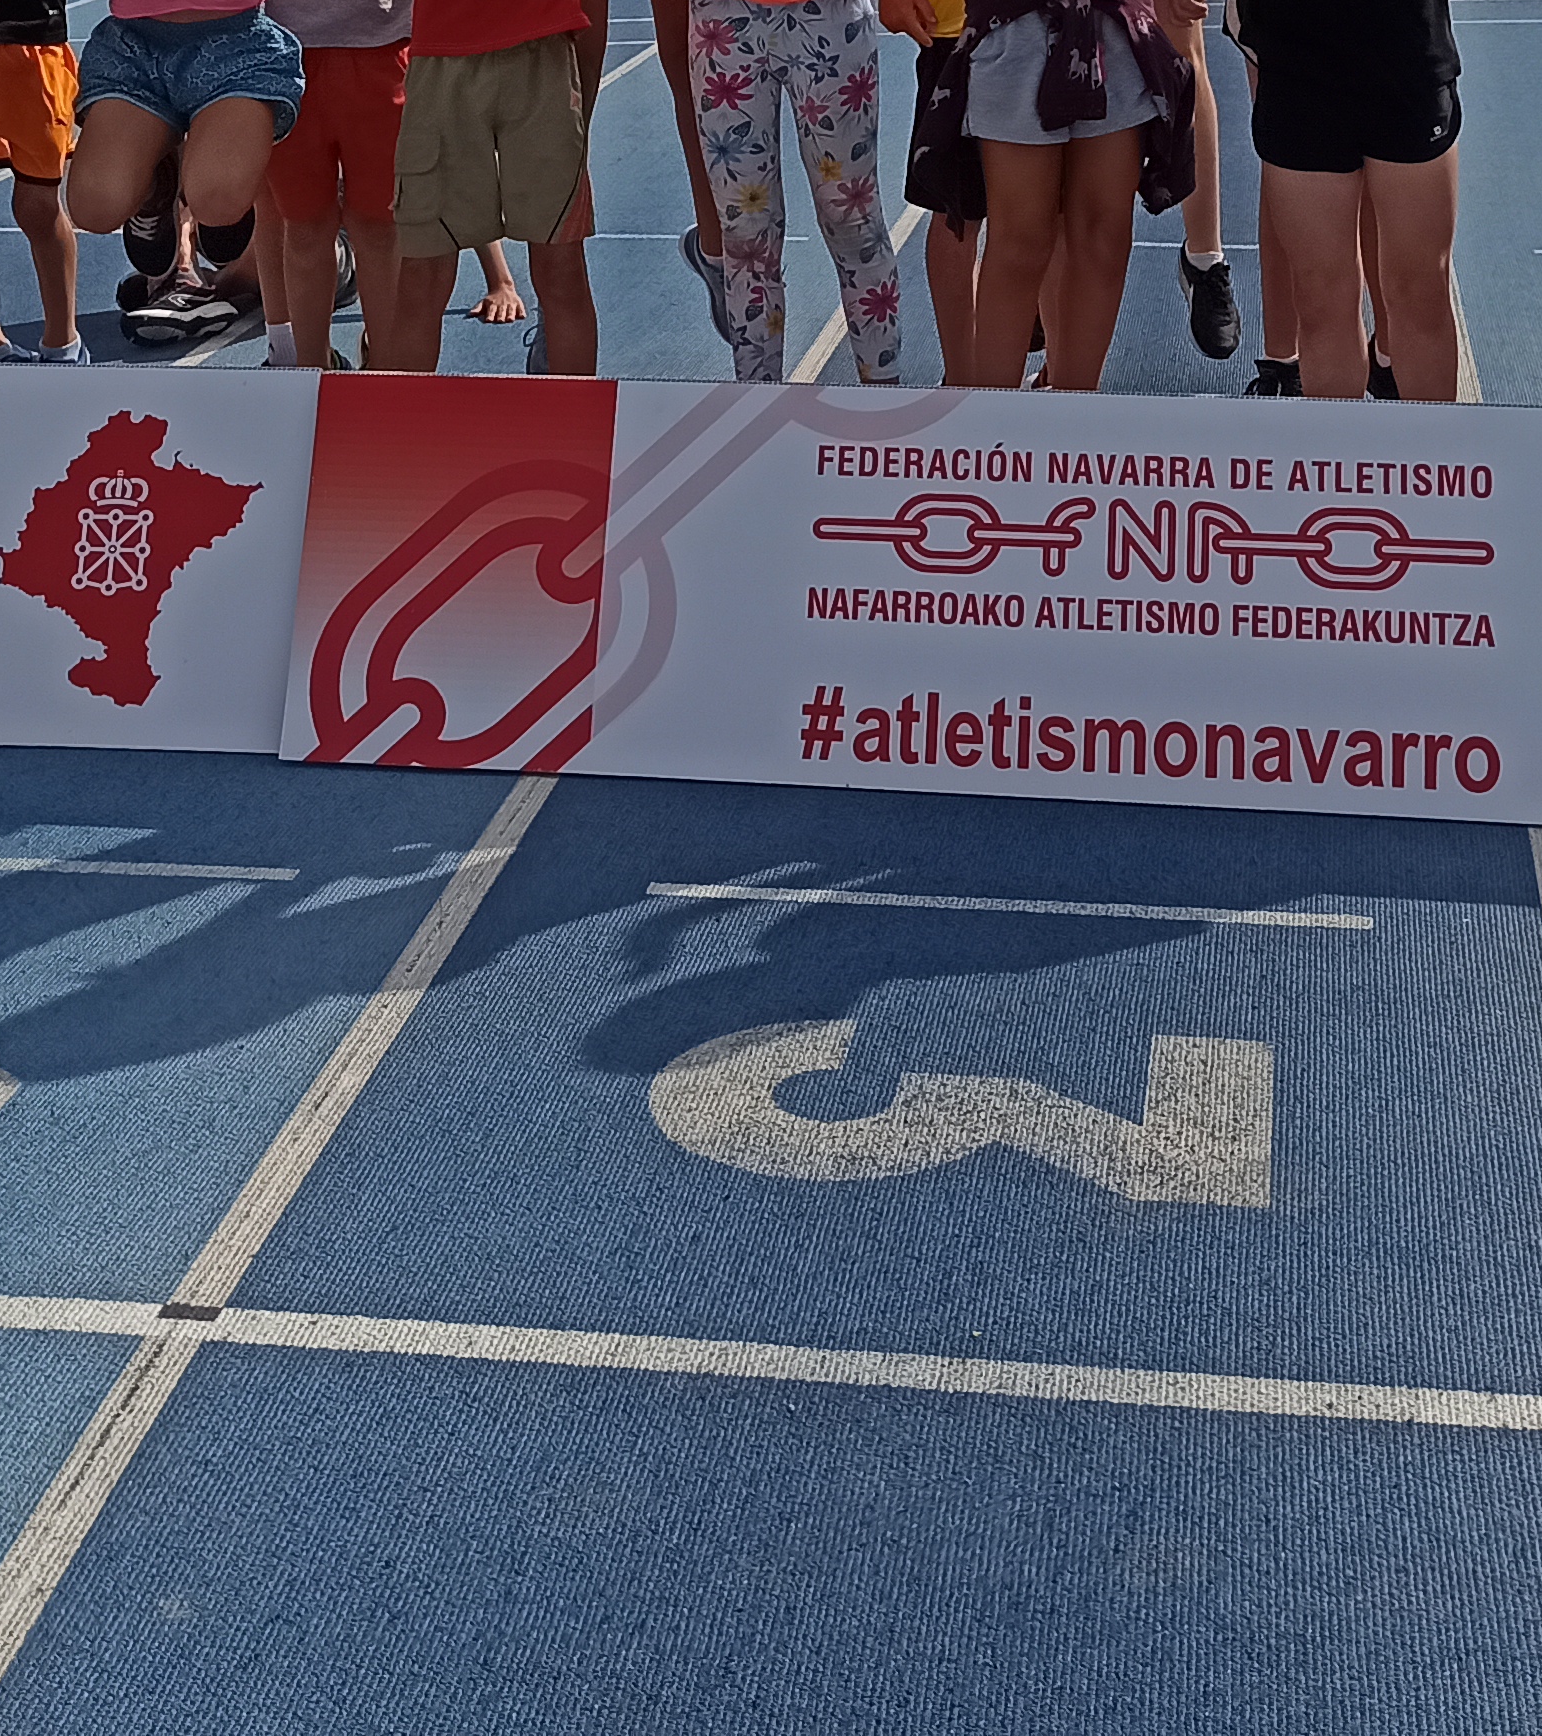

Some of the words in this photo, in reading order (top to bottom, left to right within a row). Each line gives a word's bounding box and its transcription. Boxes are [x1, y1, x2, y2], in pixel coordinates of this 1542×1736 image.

[815, 442, 1035, 484] FEDERACIÓN
[1047, 452, 1218, 490] NAVARRA
[1229, 457, 1275, 492] DE
[1286, 459, 1495, 500] ATLETISMO
[805, 586, 1026, 629] NAFARROAKO
[1034, 595, 1222, 637] ATLETISMO
[1231, 604, 1498, 649] FEDERAKUNTZA
[799, 683, 1503, 795] #atletismonavarro
[647, 1015, 1277, 1209] 3
